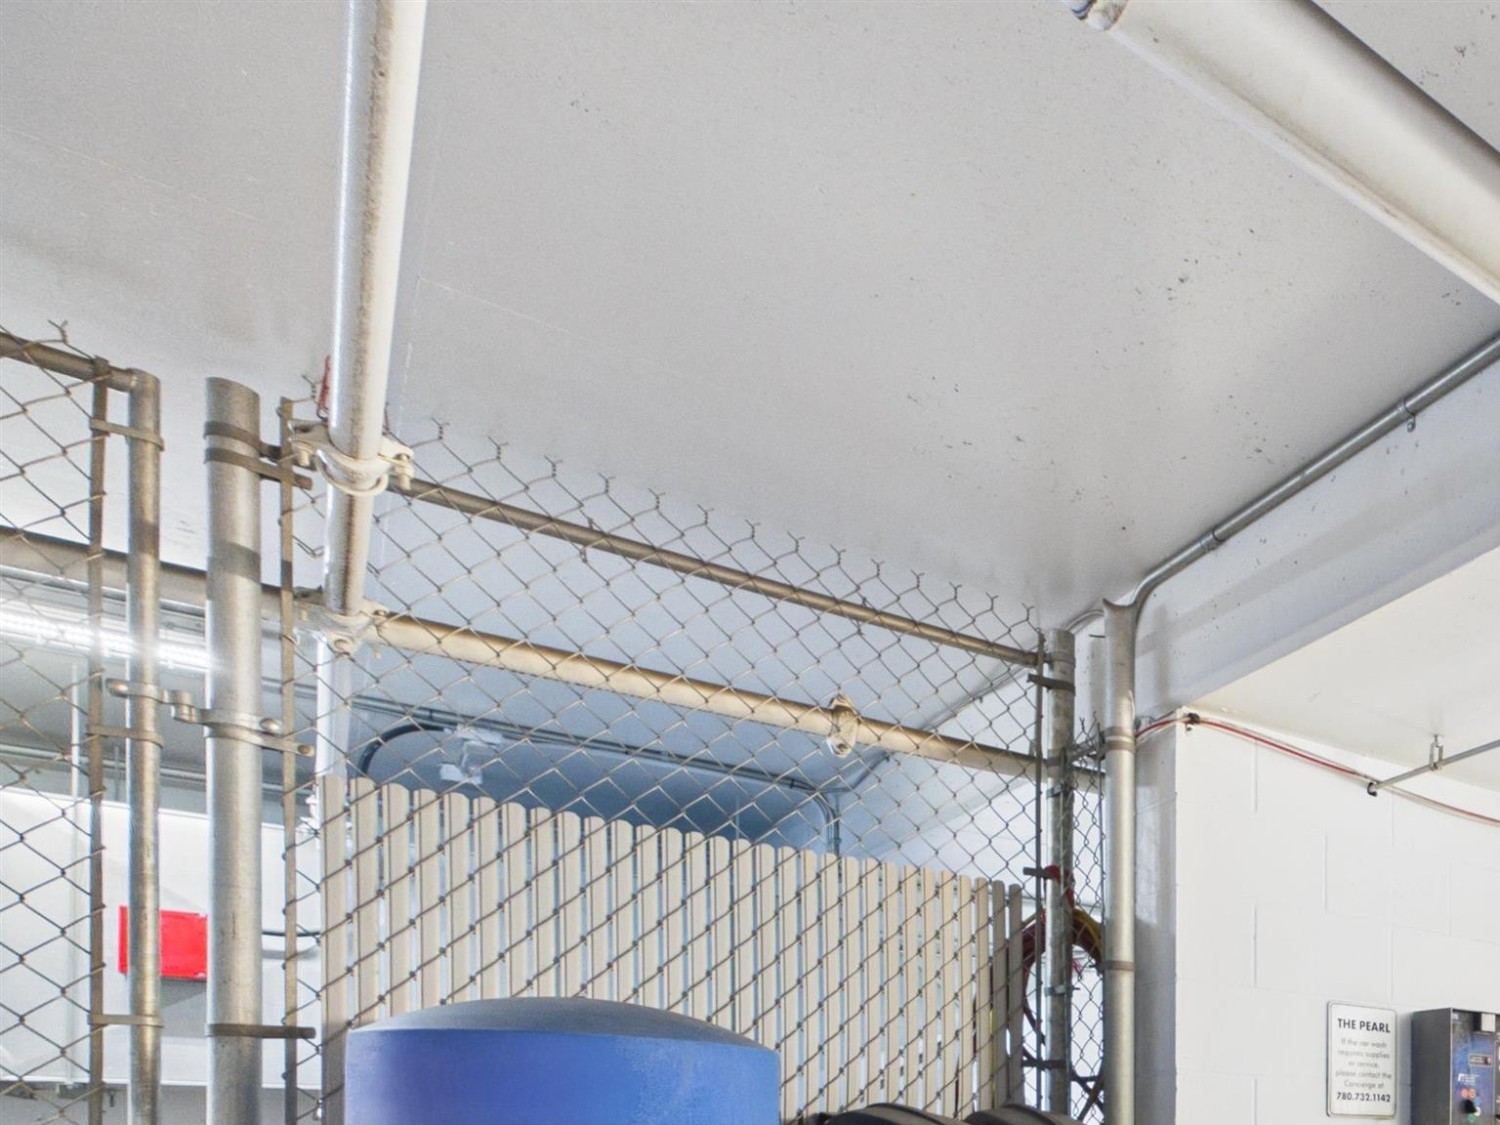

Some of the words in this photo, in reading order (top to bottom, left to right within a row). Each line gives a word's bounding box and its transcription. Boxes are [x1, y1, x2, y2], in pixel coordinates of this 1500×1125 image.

[1337, 1018, 1356, 1029] THE
[1359, 1020, 1391, 1033] PEARL
[1336, 1092, 1392, 1102] 780.732.1142
